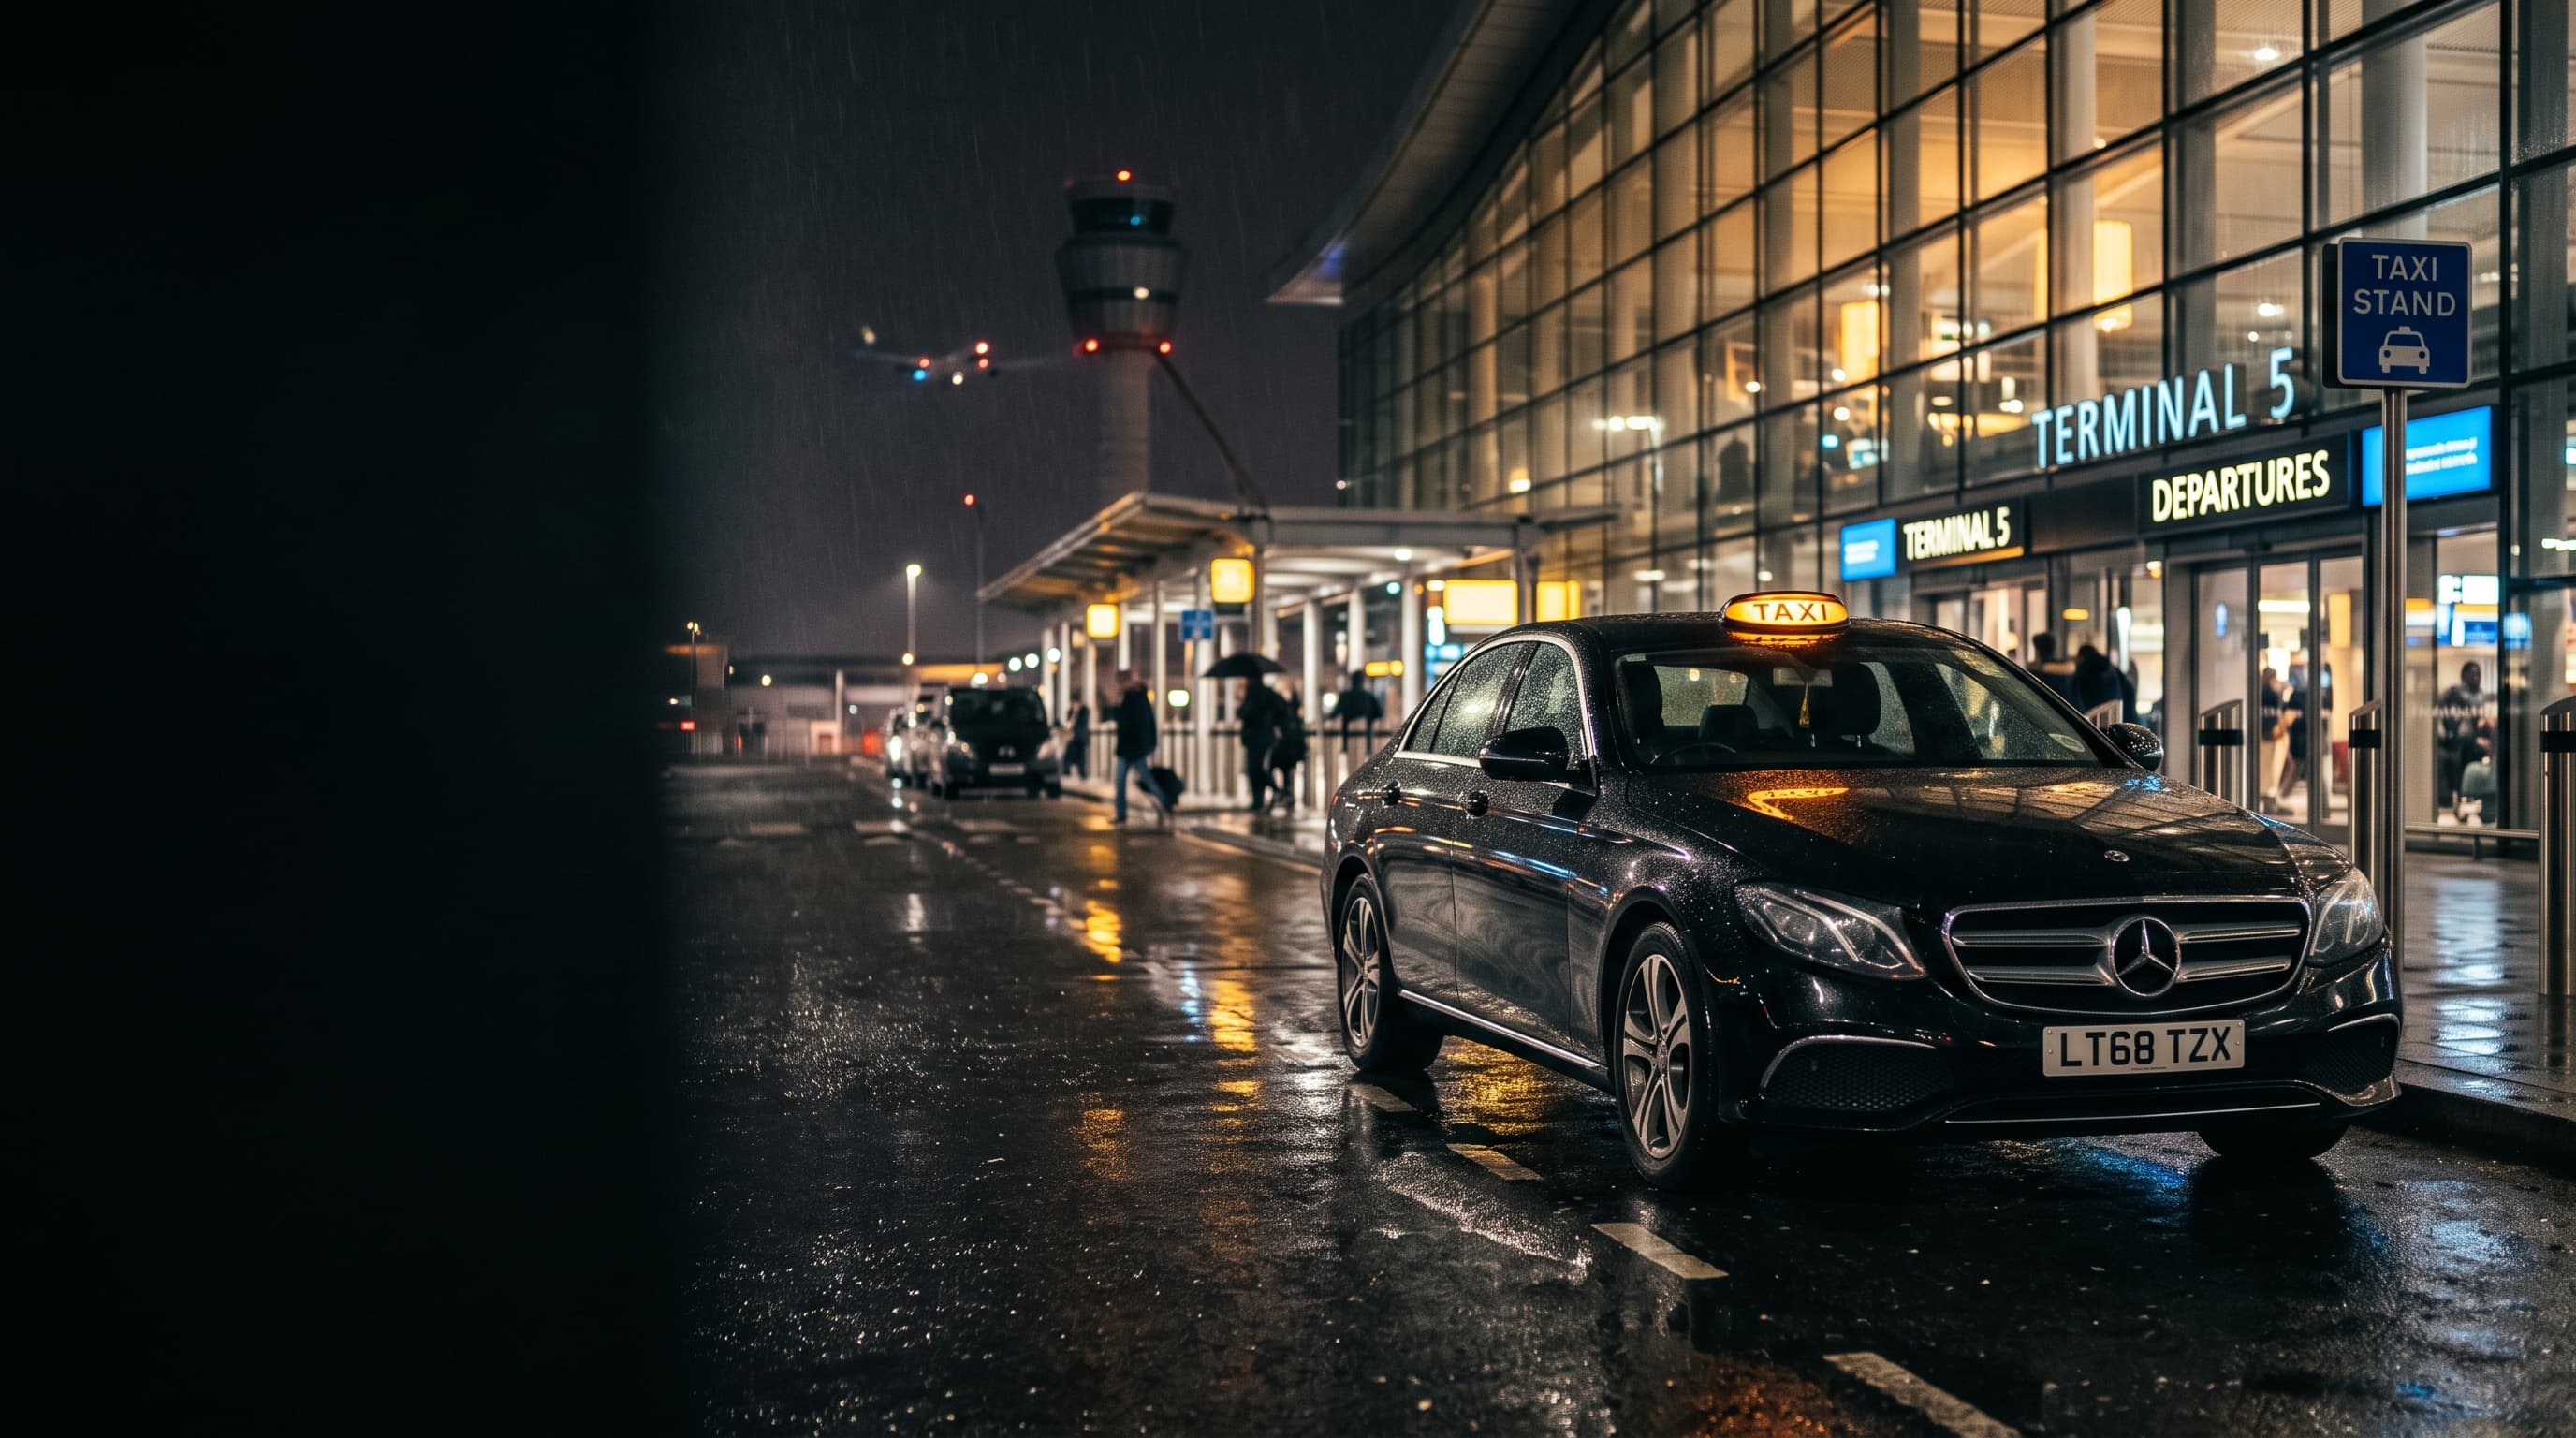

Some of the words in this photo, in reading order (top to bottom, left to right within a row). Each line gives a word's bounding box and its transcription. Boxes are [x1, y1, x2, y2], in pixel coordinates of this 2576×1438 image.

[2372, 254, 2438, 281] TAXI
[2352, 289, 2457, 318] STAND
[2032, 362, 2247, 469] TERMINAL
[2269, 346, 2296, 419] 5
[2151, 449, 2331, 523] DEPARTURES
[1902, 509, 1996, 561] TERMINAL
[1996, 506, 2012, 548] 5
[1753, 602, 1828, 622] TAXI
[2060, 1030, 2156, 1067] LT68
[2166, 1026, 2232, 1064] TZX
